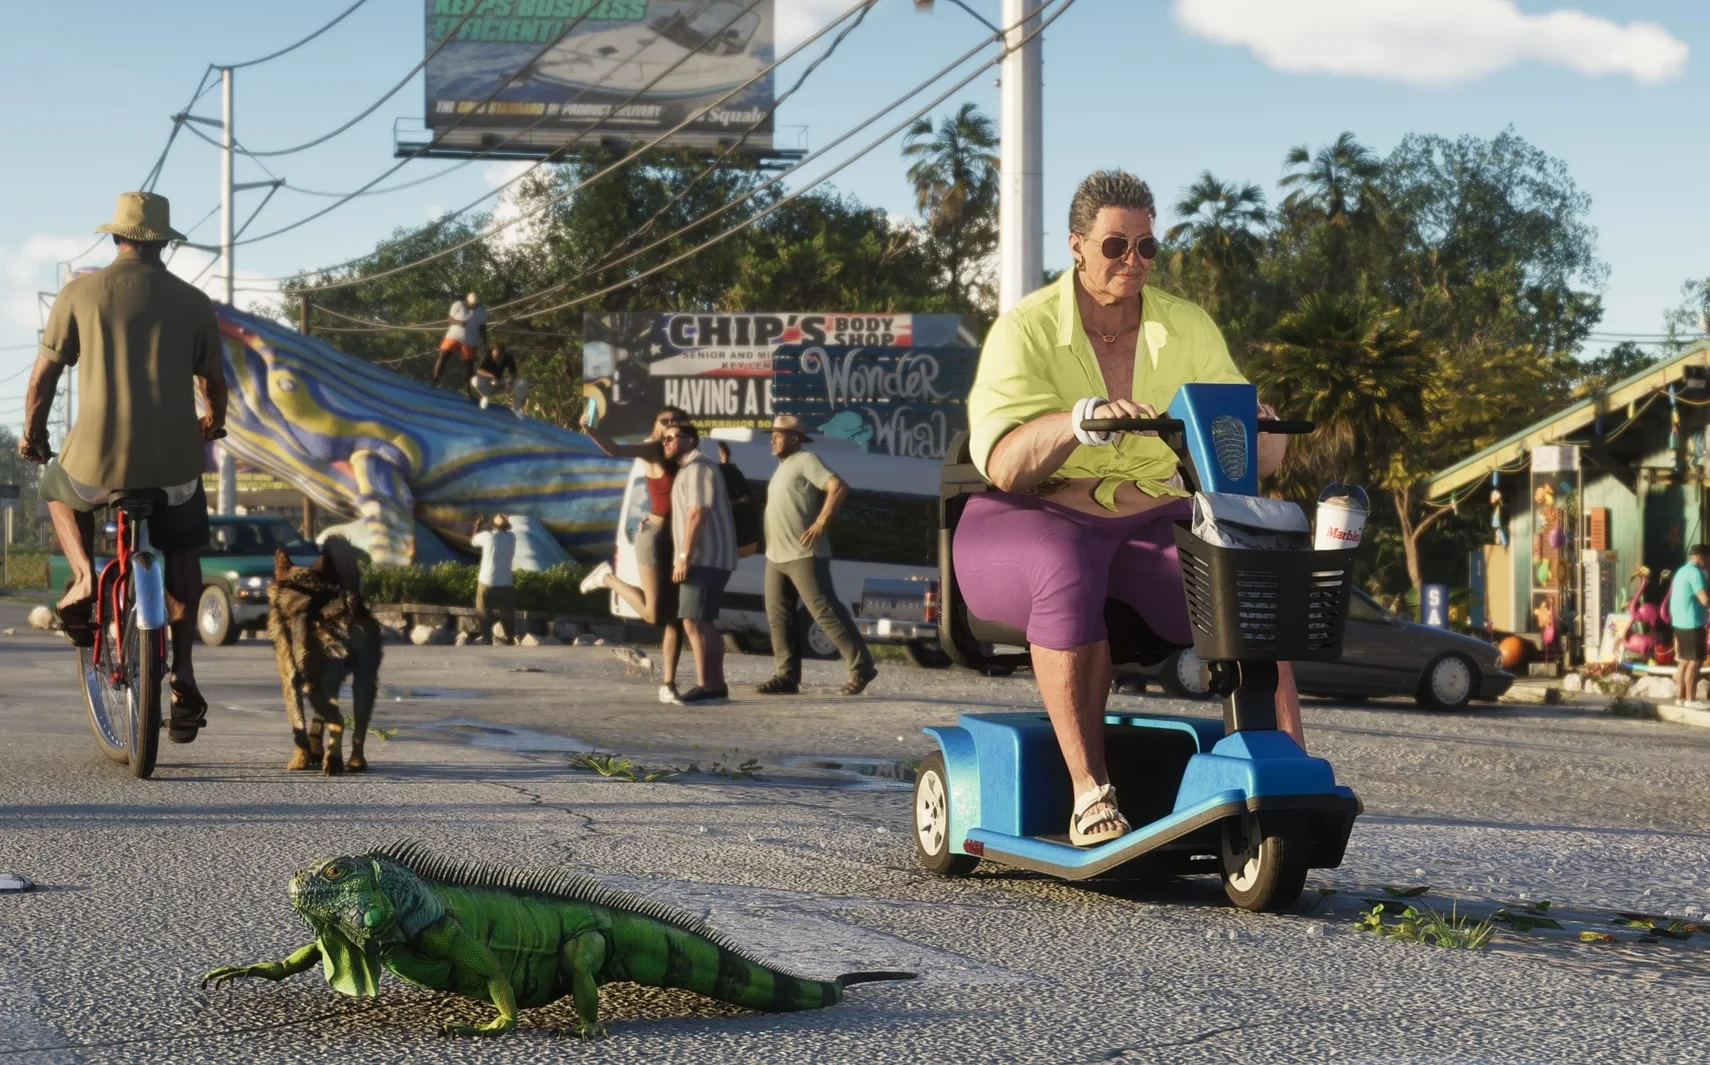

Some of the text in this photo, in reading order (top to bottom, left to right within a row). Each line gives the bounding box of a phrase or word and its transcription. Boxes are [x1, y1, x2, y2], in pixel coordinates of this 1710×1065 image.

[518, 0, 646, 19] BUSINESS
[434, 18, 564, 41] EFFICIENT!
[669, 315, 826, 346] CHIP'S
[835, 317, 894, 332] BODY
[834, 333, 895, 346] SHOP
[683, 351, 772, 359] SENIOR AND MI
[721, 361, 772, 370] KEY LEN
[665, 379, 739, 415] HAVING
[744, 379, 759, 415] A
[860, 405, 946, 460] Whal
